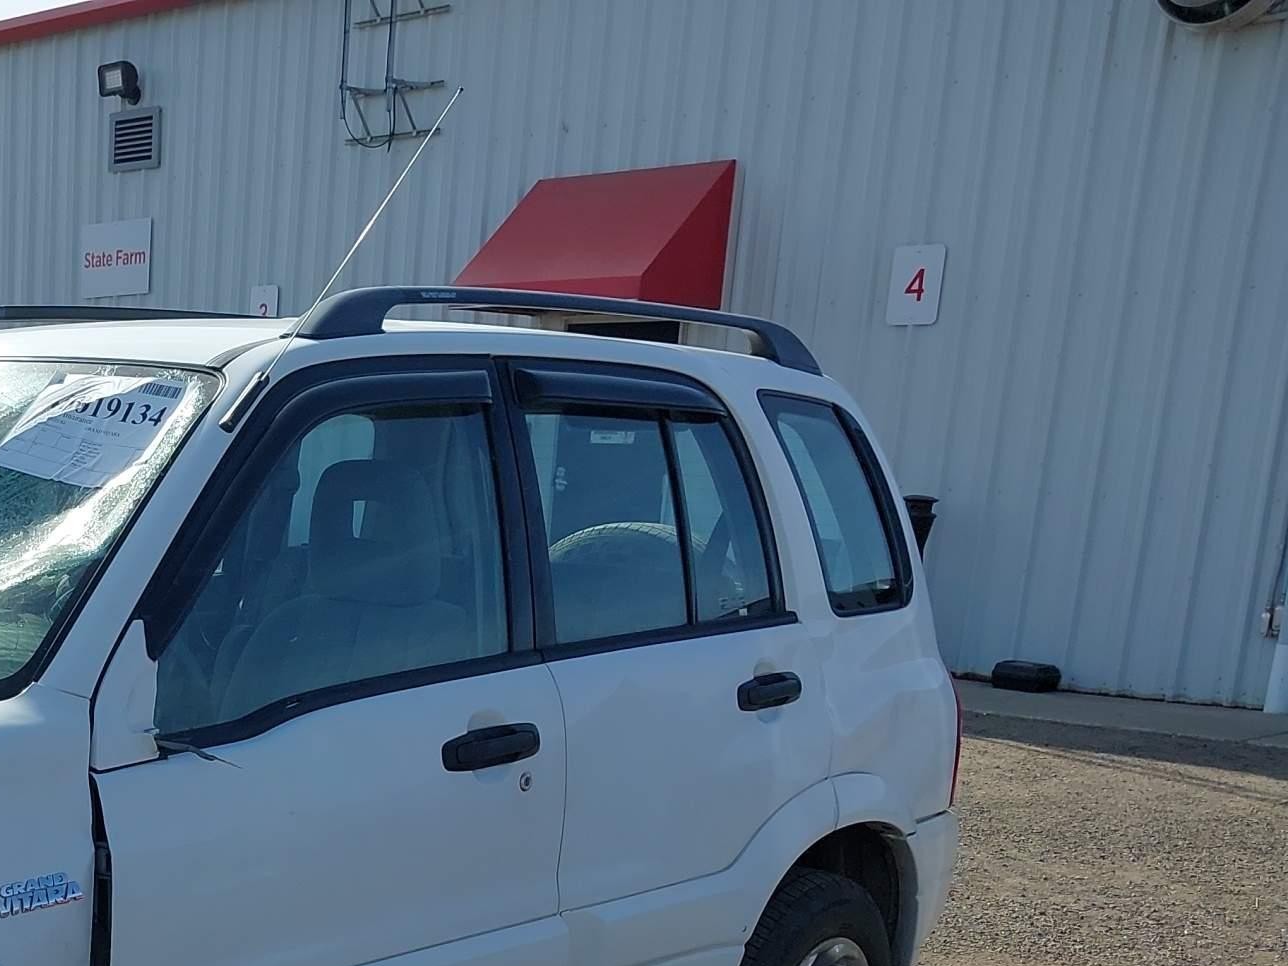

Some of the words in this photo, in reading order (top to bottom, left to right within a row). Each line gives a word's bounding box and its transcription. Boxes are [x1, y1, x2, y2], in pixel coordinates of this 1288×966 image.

[84, 252, 113, 269] State
[115, 249, 146, 266] Farm
[903, 268, 925, 302] 4
[0, 872, 70, 898] GRAND
